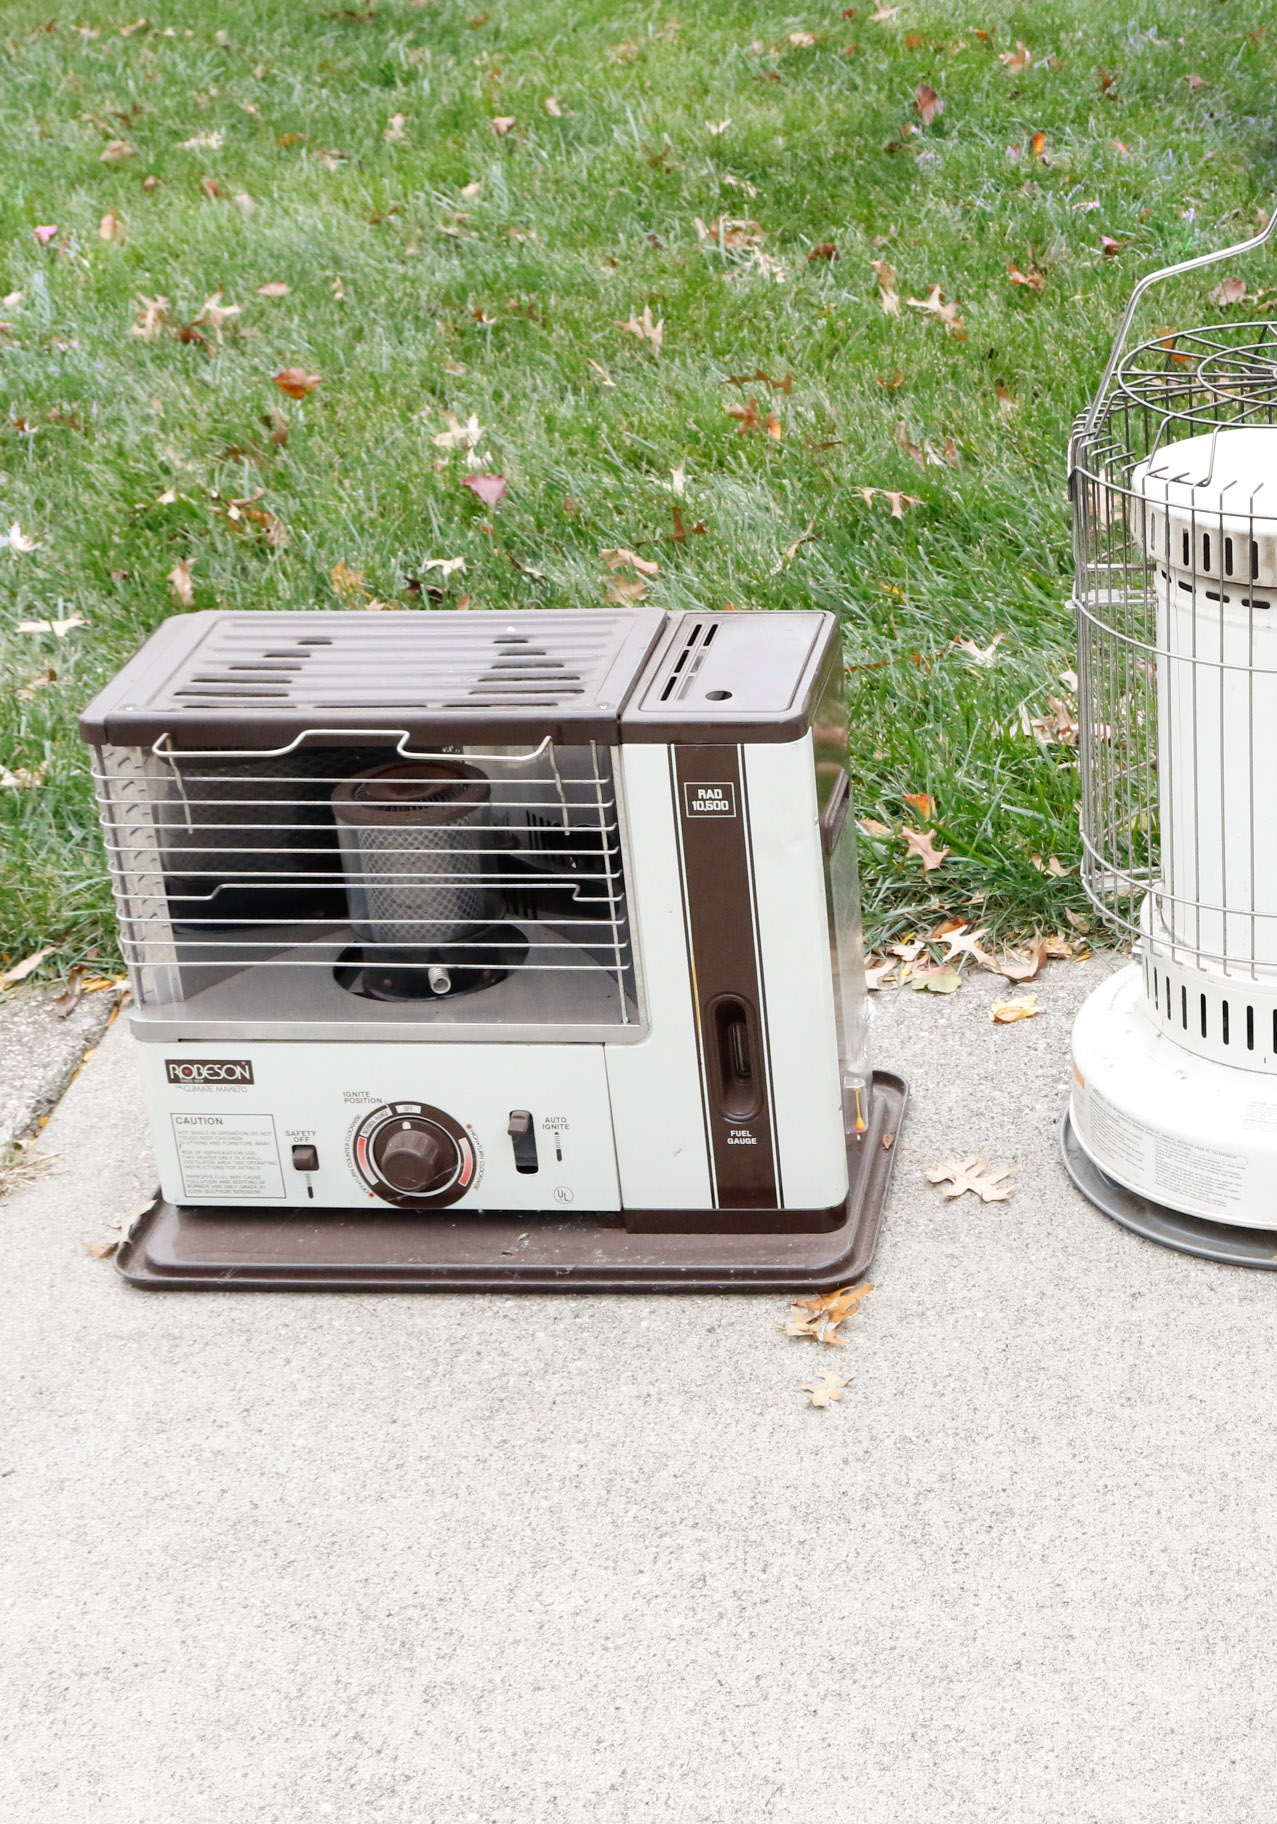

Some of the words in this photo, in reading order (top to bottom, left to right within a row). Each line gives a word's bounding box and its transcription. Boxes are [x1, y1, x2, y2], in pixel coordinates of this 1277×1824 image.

[698, 789, 722, 799] RAD
[691, 800, 729, 811] 10,500
[168, 1064, 251, 1080] ROBESON
[175, 1116, 223, 1125] CAUTION
[727, 1137, 758, 1145] GAUGE
